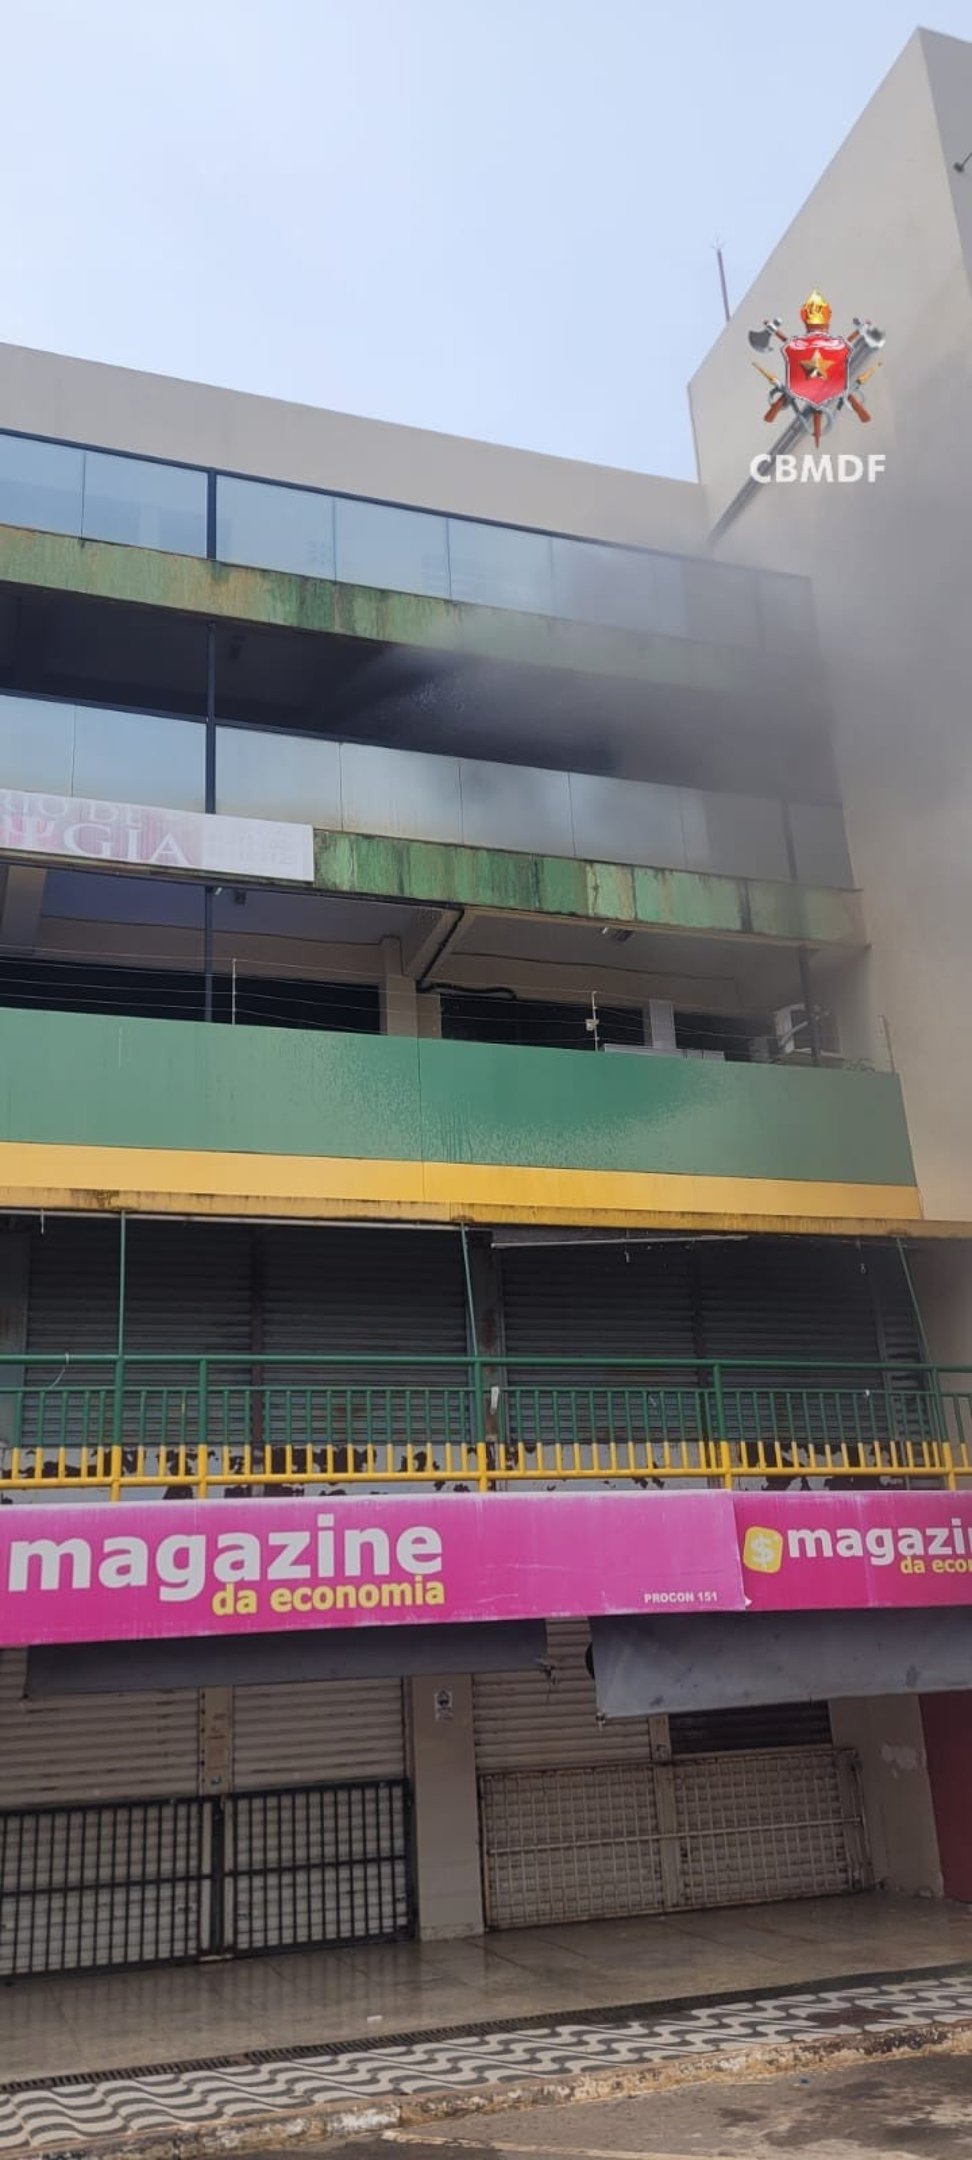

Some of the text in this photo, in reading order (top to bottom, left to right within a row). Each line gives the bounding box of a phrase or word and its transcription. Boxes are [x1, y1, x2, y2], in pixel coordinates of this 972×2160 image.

[90, 800, 143, 827] DE
[8, 1513, 443, 1601] magazine
[787, 1517, 972, 1566] magazi
[900, 1556, 972, 1574] da eco
[212, 1574, 445, 1616] da economia
[643, 1590, 718, 1603] PROCON 151
